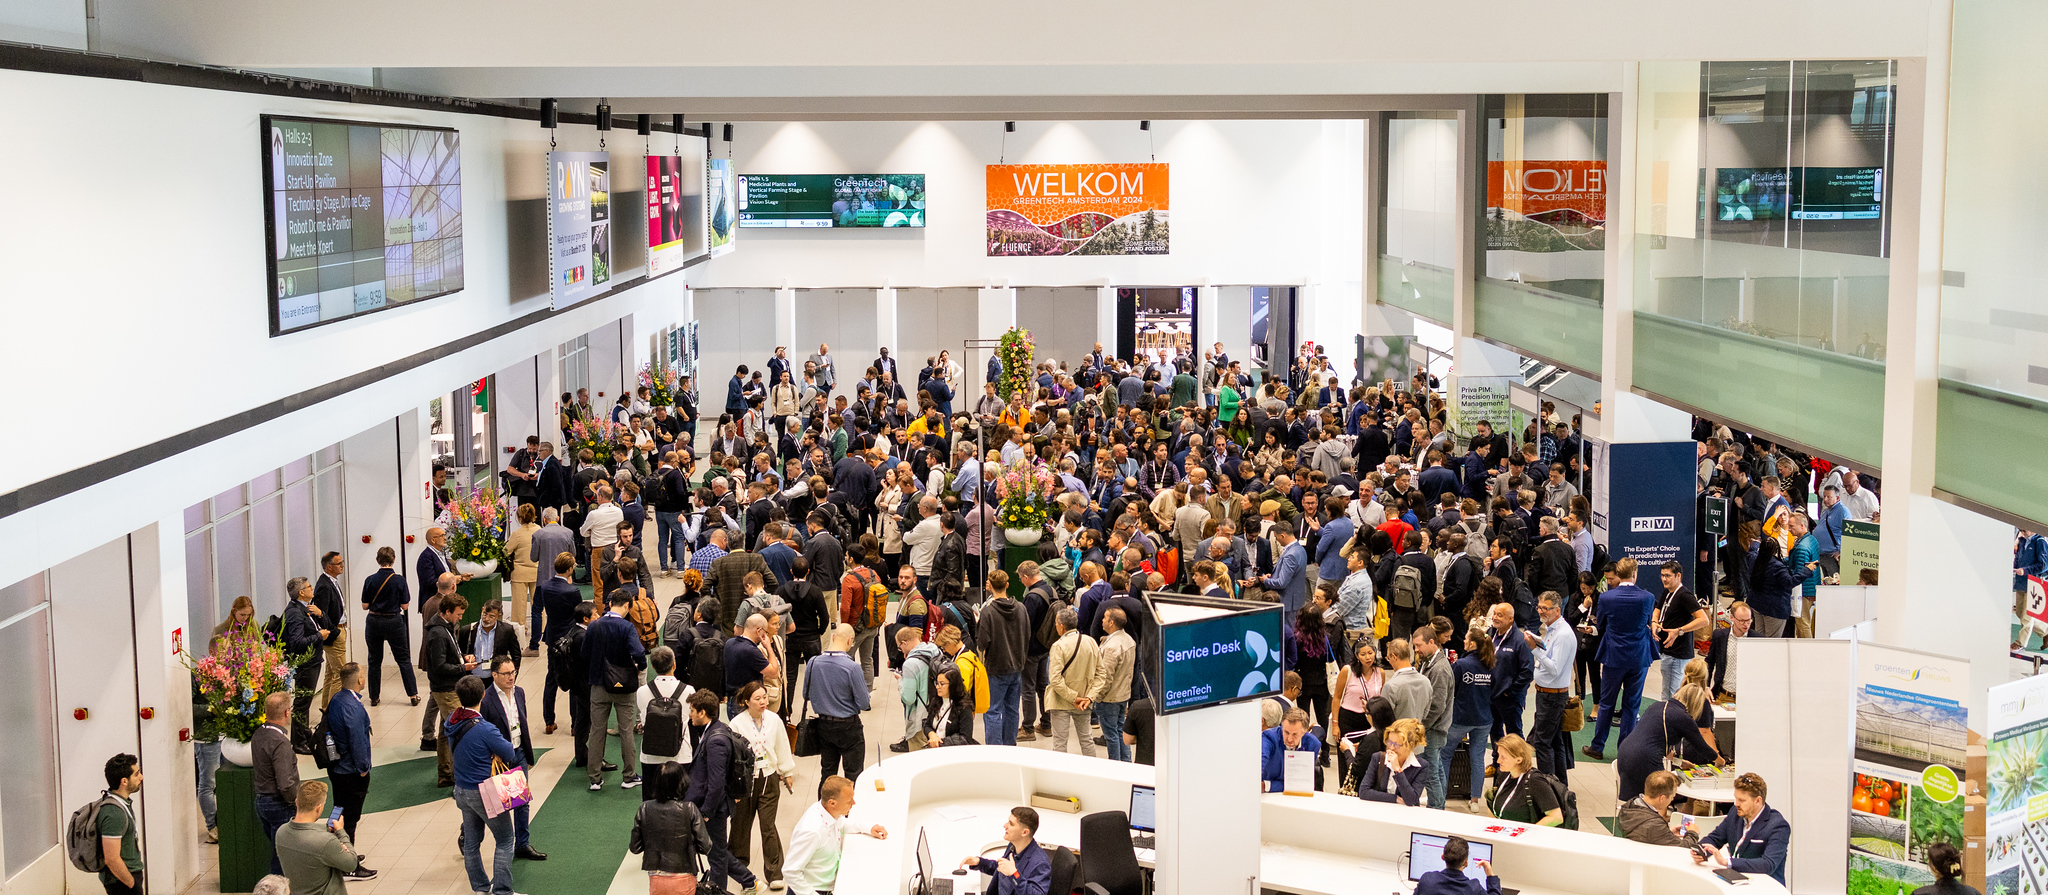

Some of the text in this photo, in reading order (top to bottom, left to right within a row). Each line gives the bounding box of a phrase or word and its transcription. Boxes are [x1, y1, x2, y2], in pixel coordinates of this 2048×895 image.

[285, 128, 312, 146] Halls 2-3
[286, 152, 333, 166] Innovation Zone
[288, 173, 336, 192] Start-Up Pavilion
[557, 161, 585, 200] RAYN
[835, 178, 887, 187] GreenTech
[1013, 172, 1144, 196] WELKOM
[288, 194, 370, 213] Technology Stage, Drone Cage
[1013, 197, 1064, 205] GREENTECH
[289, 219, 308, 234] Robot
[309, 219, 326, 232] Dome
[327, 217, 331, 231] &
[290, 240, 334, 257] Meet the Xpert
[1002, 242, 1032, 252] FLUENCE
[370, 290, 382, 305] 9:59
[281, 310, 289, 319] You
[302, 305, 318, 314] Entrance
[1634, 519, 1672, 529] PRIVA
[1854, 528, 1878, 536] GreenTech
[1166, 639, 1241, 663] Service Desk
[1874, 663, 1952, 683] groenten nieuws
[1166, 684, 1212, 700] GreenTech
[1866, 687, 1884, 695] Nieuws
[1884, 690, 1914, 700] Nederlandse
